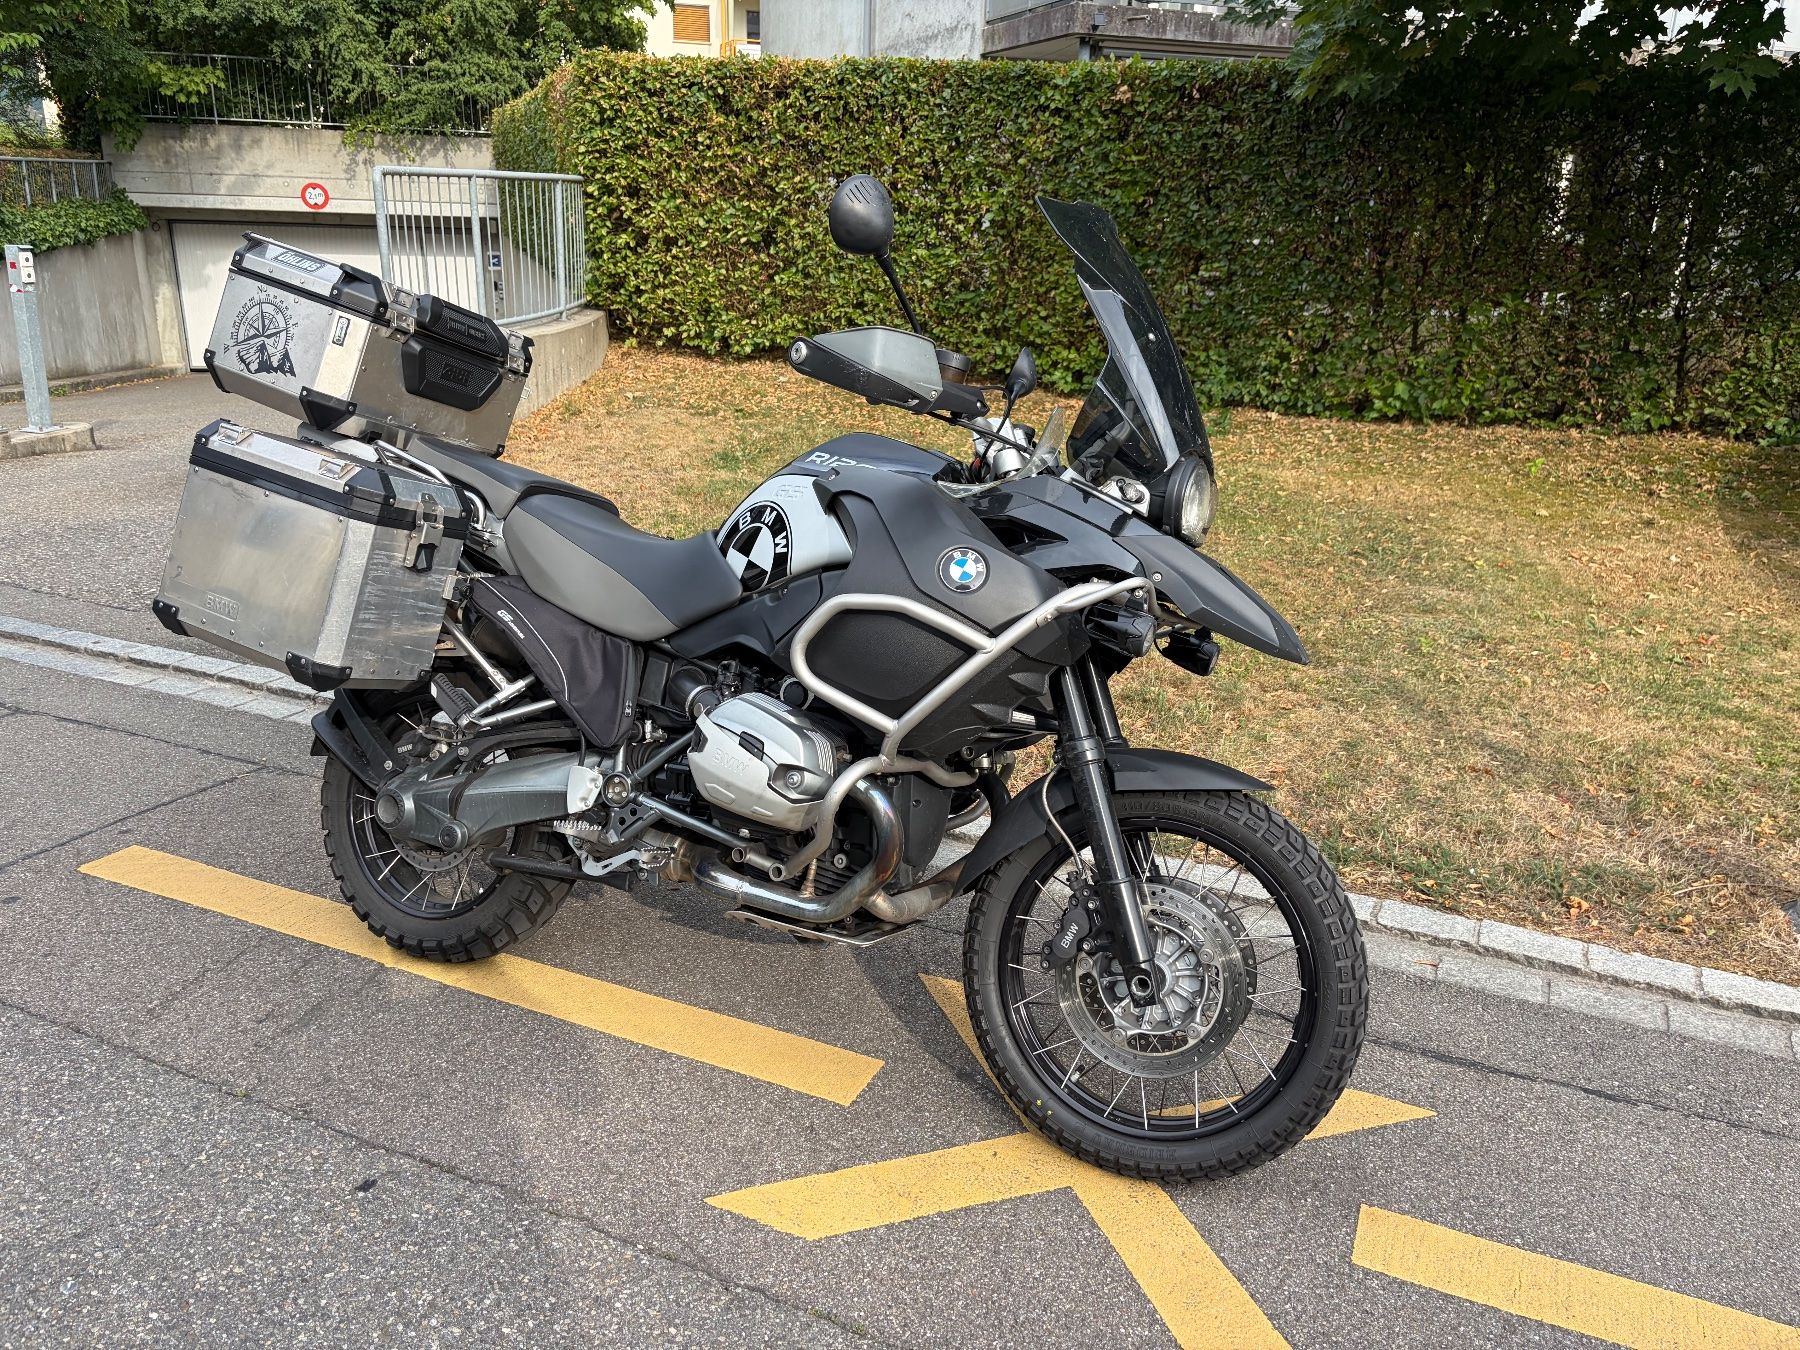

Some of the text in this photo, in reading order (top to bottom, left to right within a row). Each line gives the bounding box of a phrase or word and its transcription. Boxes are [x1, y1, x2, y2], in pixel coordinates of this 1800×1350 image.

[277, 251, 322, 271] ÖHLINS
[739, 506, 788, 553] BMW
[952, 551, 984, 571] BMW
[206, 594, 239, 620] BMW
[396, 743, 413, 754] BMW
[711, 747, 750, 776] BMW
[1060, 922, 1079, 949] BMW
